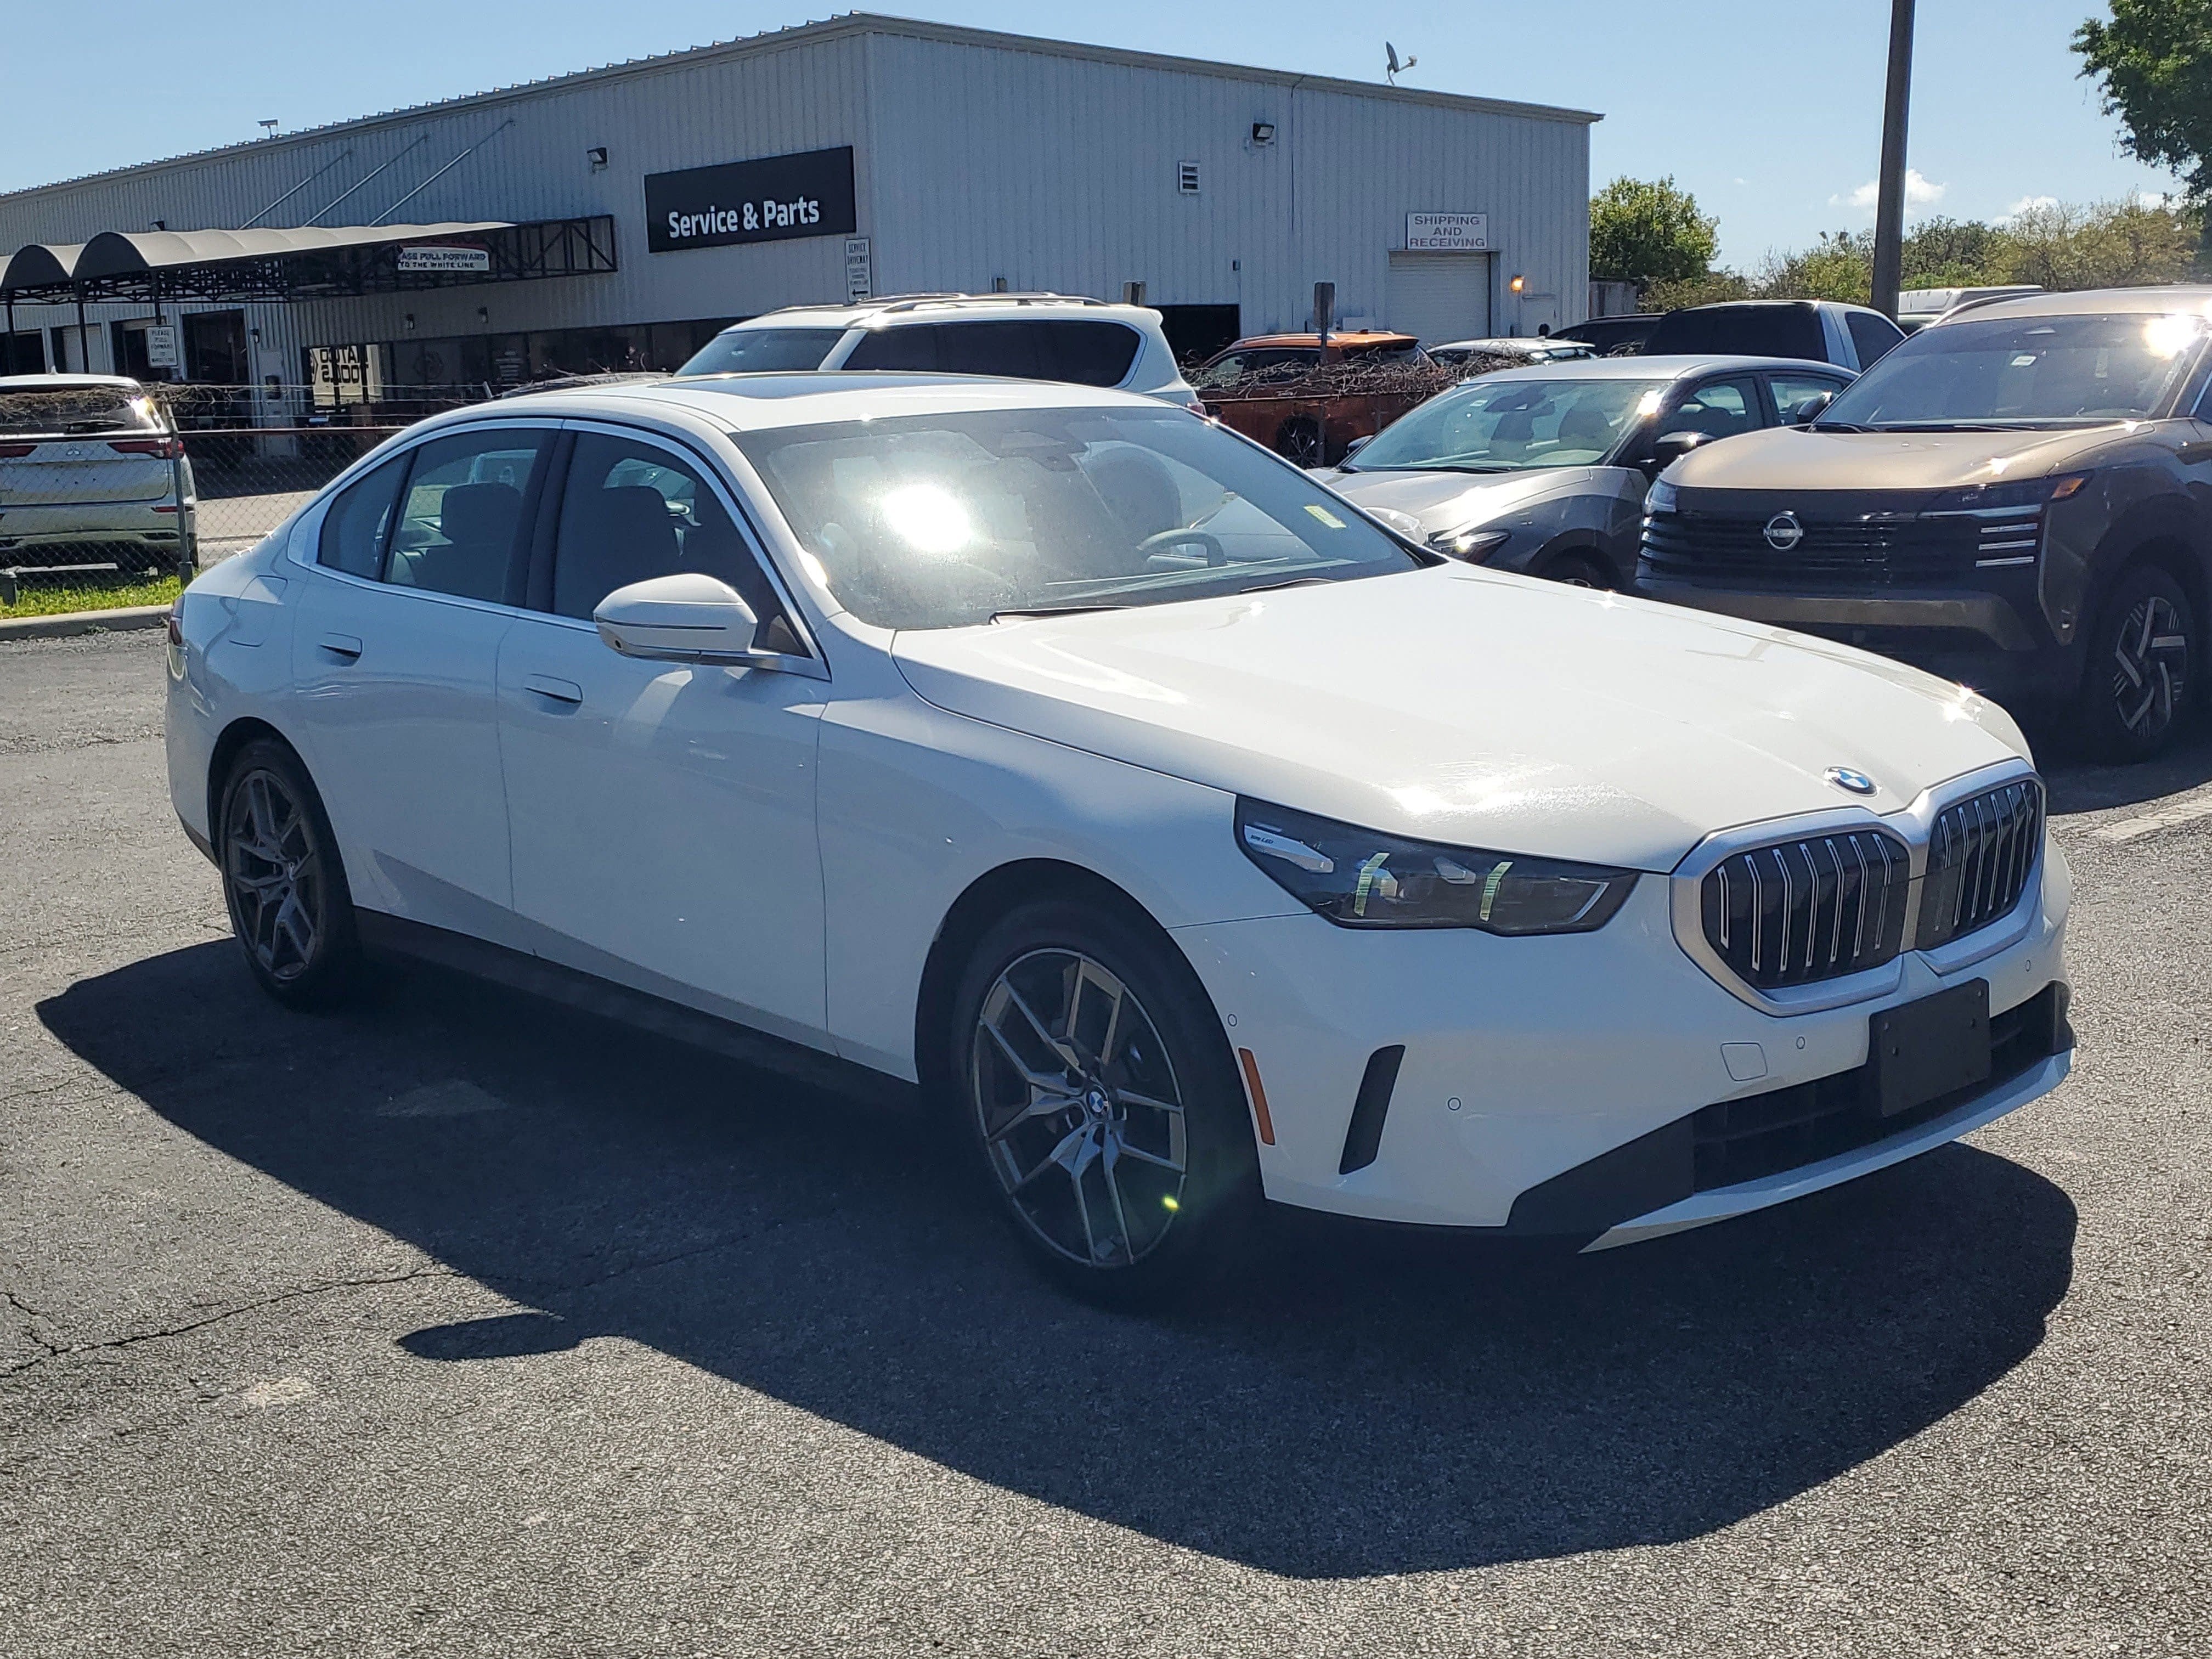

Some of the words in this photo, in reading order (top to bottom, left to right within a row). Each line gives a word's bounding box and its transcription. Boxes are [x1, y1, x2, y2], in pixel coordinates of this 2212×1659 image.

[668, 205, 738, 238] Service
[743, 202, 760, 230] &
[763, 196, 820, 228] Parts
[1414, 216, 1480, 225] SHIPPING
[1432, 227, 1463, 236] AND
[1409, 238, 1485, 247] RECEIVING
